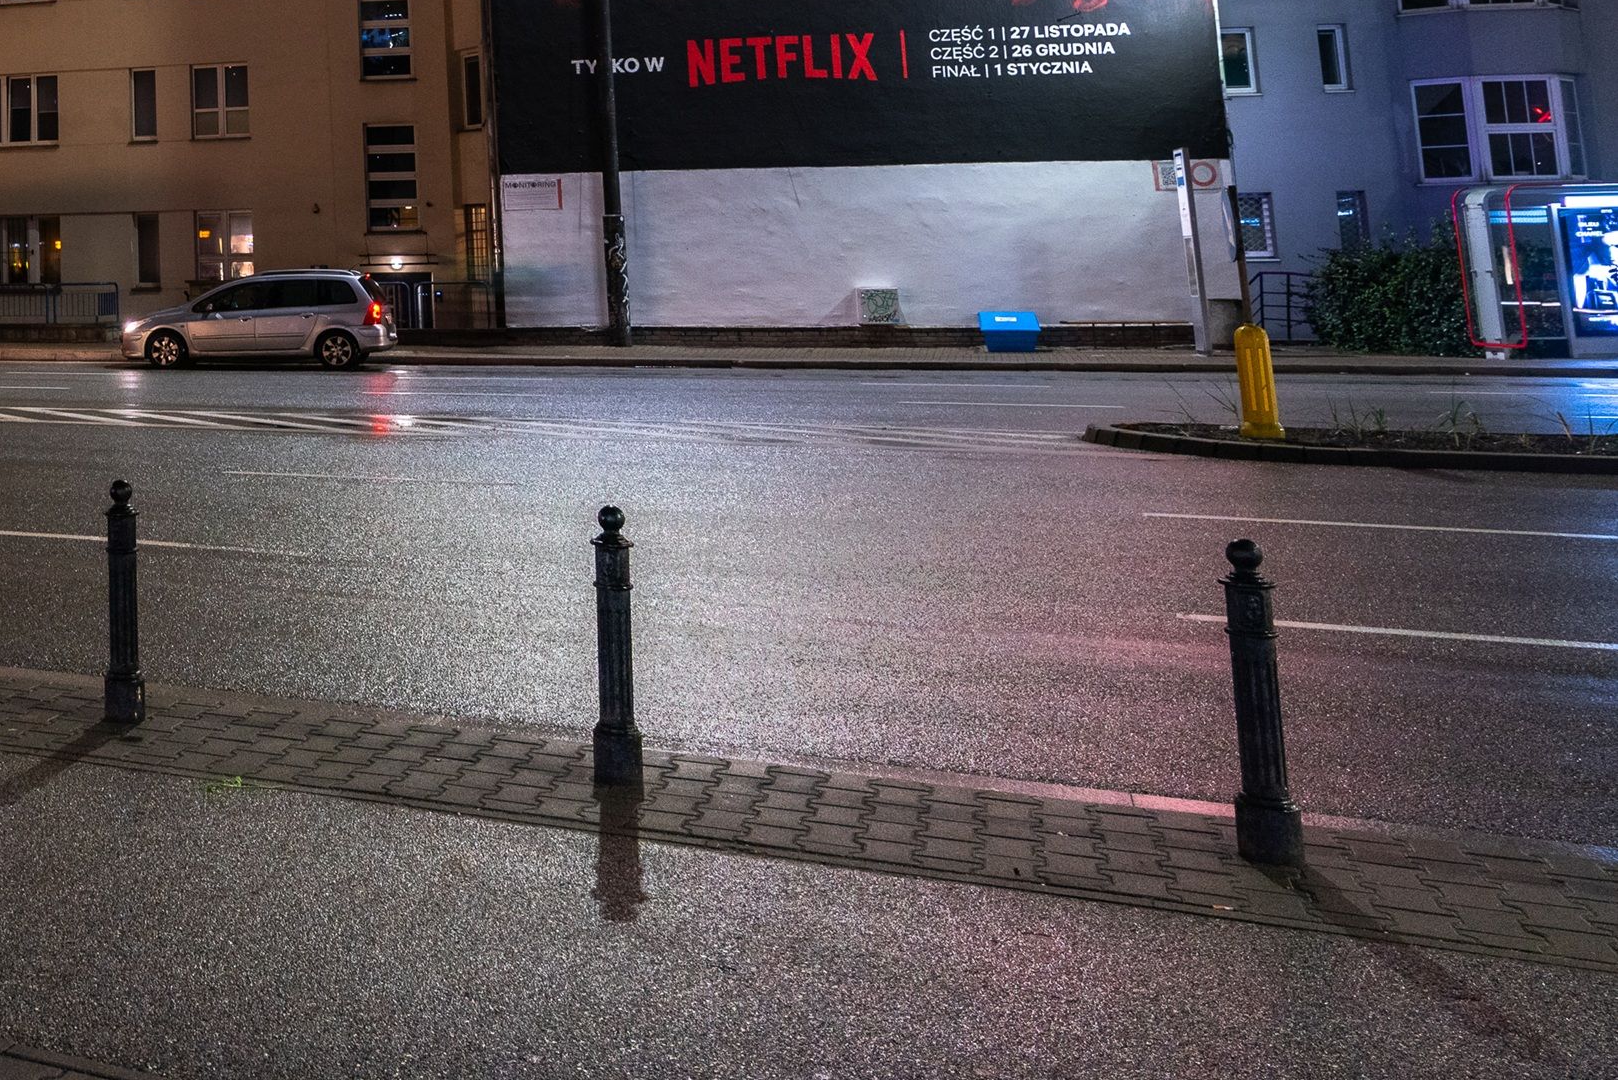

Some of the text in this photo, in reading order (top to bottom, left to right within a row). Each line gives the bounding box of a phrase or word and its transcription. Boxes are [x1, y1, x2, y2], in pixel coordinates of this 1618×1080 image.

[928, 25, 984, 44] CZĘŚĆ
[988, 27, 996, 40] 1
[1010, 26, 1030, 39] 27
[1034, 22, 1131, 38] LISTOPADA
[687, 32, 878, 88] NETFLIX
[930, 44, 985, 63] CZĘŚĆ
[988, 46, 999, 58] 2
[1011, 44, 1032, 57] 26
[1036, 41, 1115, 56] GRUDNIA
[571, 56, 665, 74] TYKO W
[932, 64, 981, 78] FINAŁ
[994, 64, 1002, 76] 1
[1007, 61, 1093, 75] STYCZNIA
